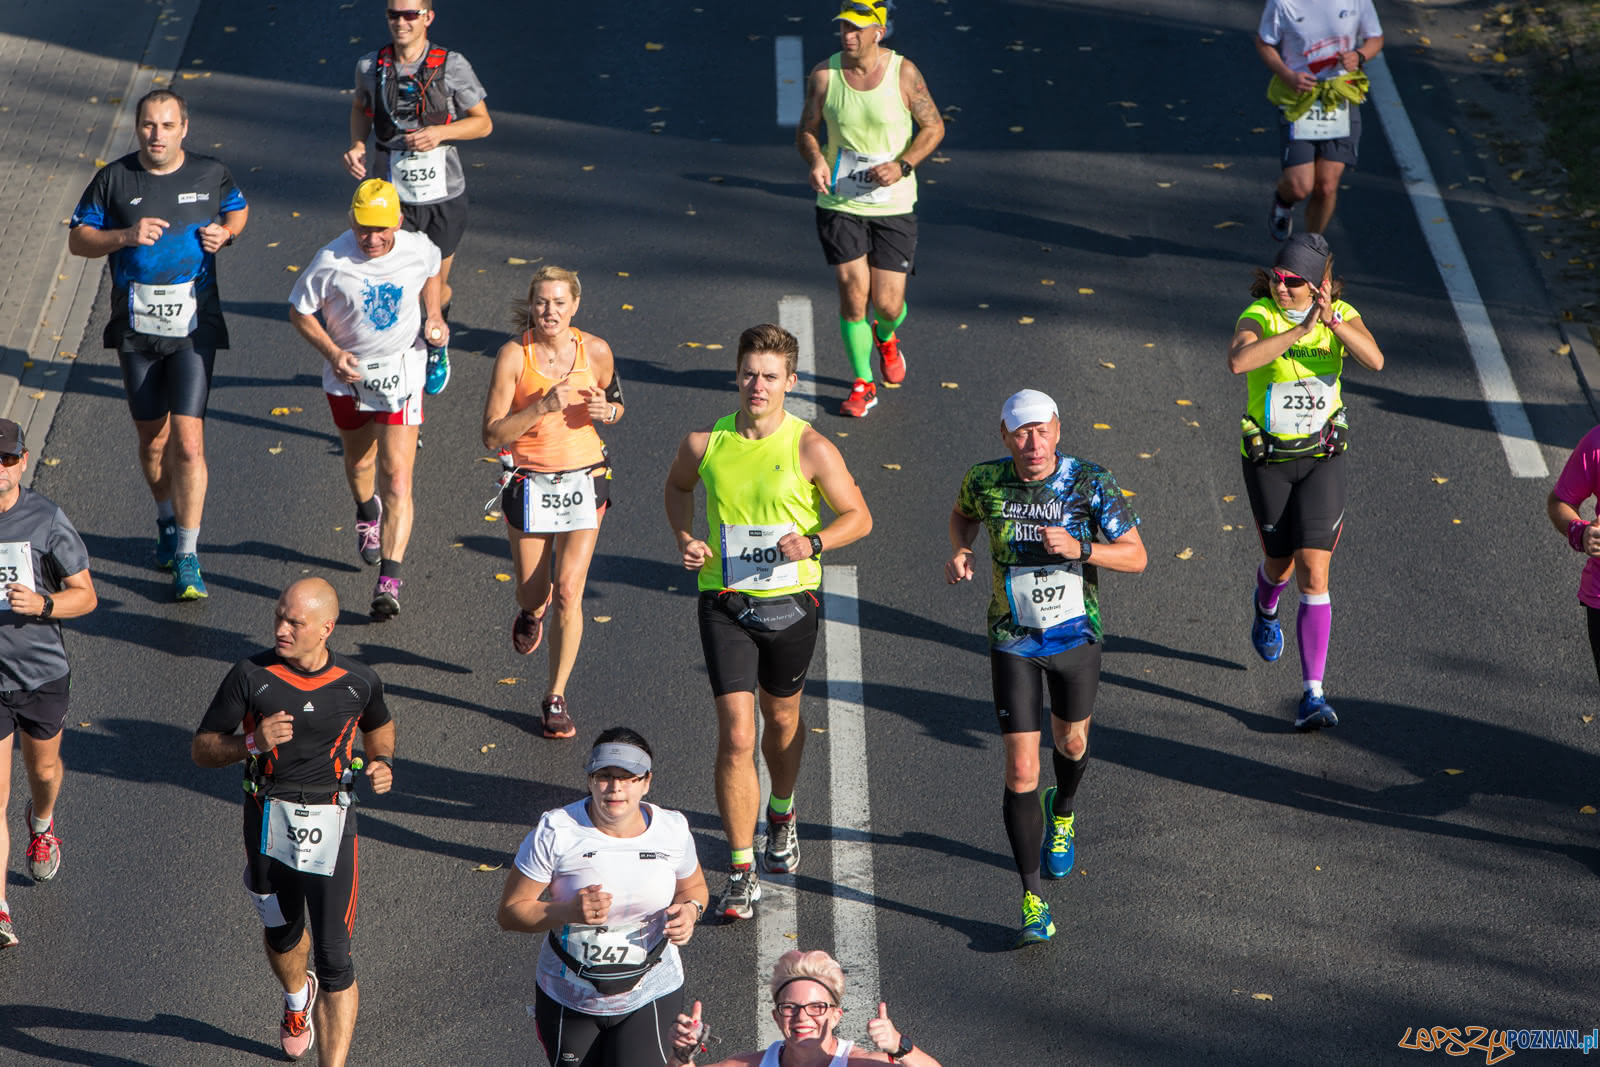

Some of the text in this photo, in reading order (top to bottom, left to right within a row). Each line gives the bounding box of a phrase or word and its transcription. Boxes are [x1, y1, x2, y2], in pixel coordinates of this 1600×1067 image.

[1306, 108, 1337, 121] 2122
[400, 167, 436, 182] 2536
[848, 168, 873, 183] 418
[147, 303, 183, 317] 2137
[363, 374, 400, 392] 4949
[1283, 395, 1326, 410] 2336
[541, 491, 583, 509] 5360
[1002, 498, 1062, 520] CHRZANÓW
[1015, 522, 1047, 542] BIEG
[740, 546, 785, 563] 4801
[1032, 585, 1065, 604] 897
[286, 825, 323, 844] 590
[581, 942, 629, 963] 1247
